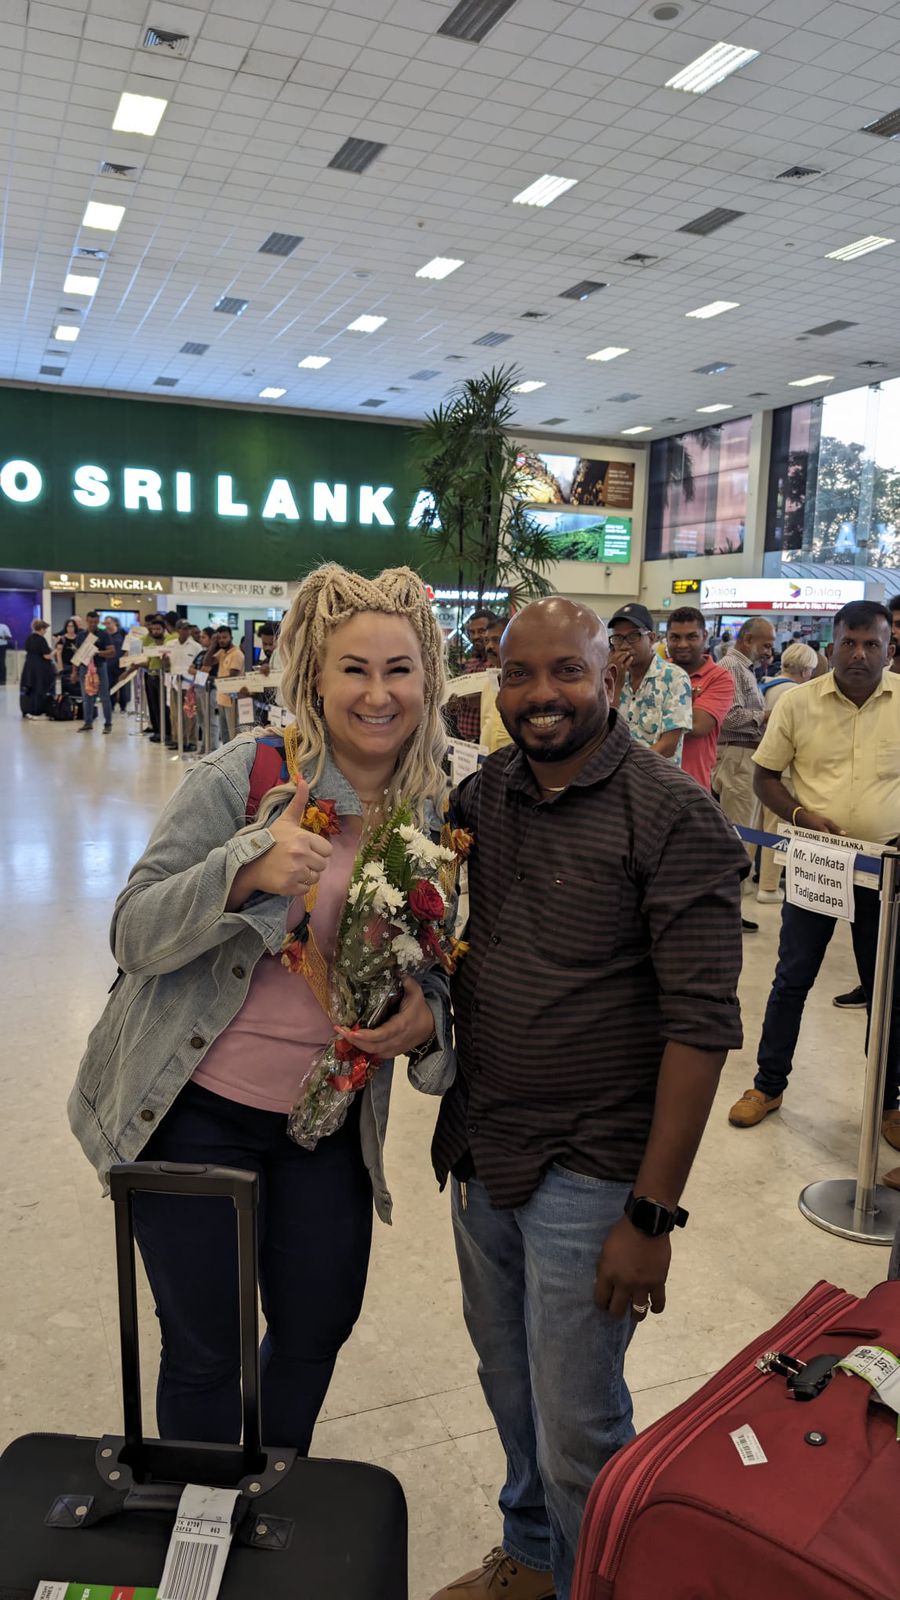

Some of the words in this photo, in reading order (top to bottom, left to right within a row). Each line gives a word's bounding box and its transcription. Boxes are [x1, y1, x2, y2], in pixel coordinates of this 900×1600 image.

[73, 464, 192, 512] SRI
[217, 474, 441, 528] LANKA
[89, 577, 163, 591] SHANGRI-LA
[176, 581, 198, 592] THE
[203, 583, 266, 596] KINGSBURY
[804, 585, 842, 599] Dialog
[794, 829, 820, 841] WELCOME
[830, 838, 840, 846] SRI
[841, 841, 864, 851] LANKA
[793, 848, 807, 862] Mr.
[810, 852, 845, 871] Venkata
[795, 866, 816, 882] Phani
[818, 873, 842, 889] Kiran
[794, 883, 843, 907] Tadigadapa
